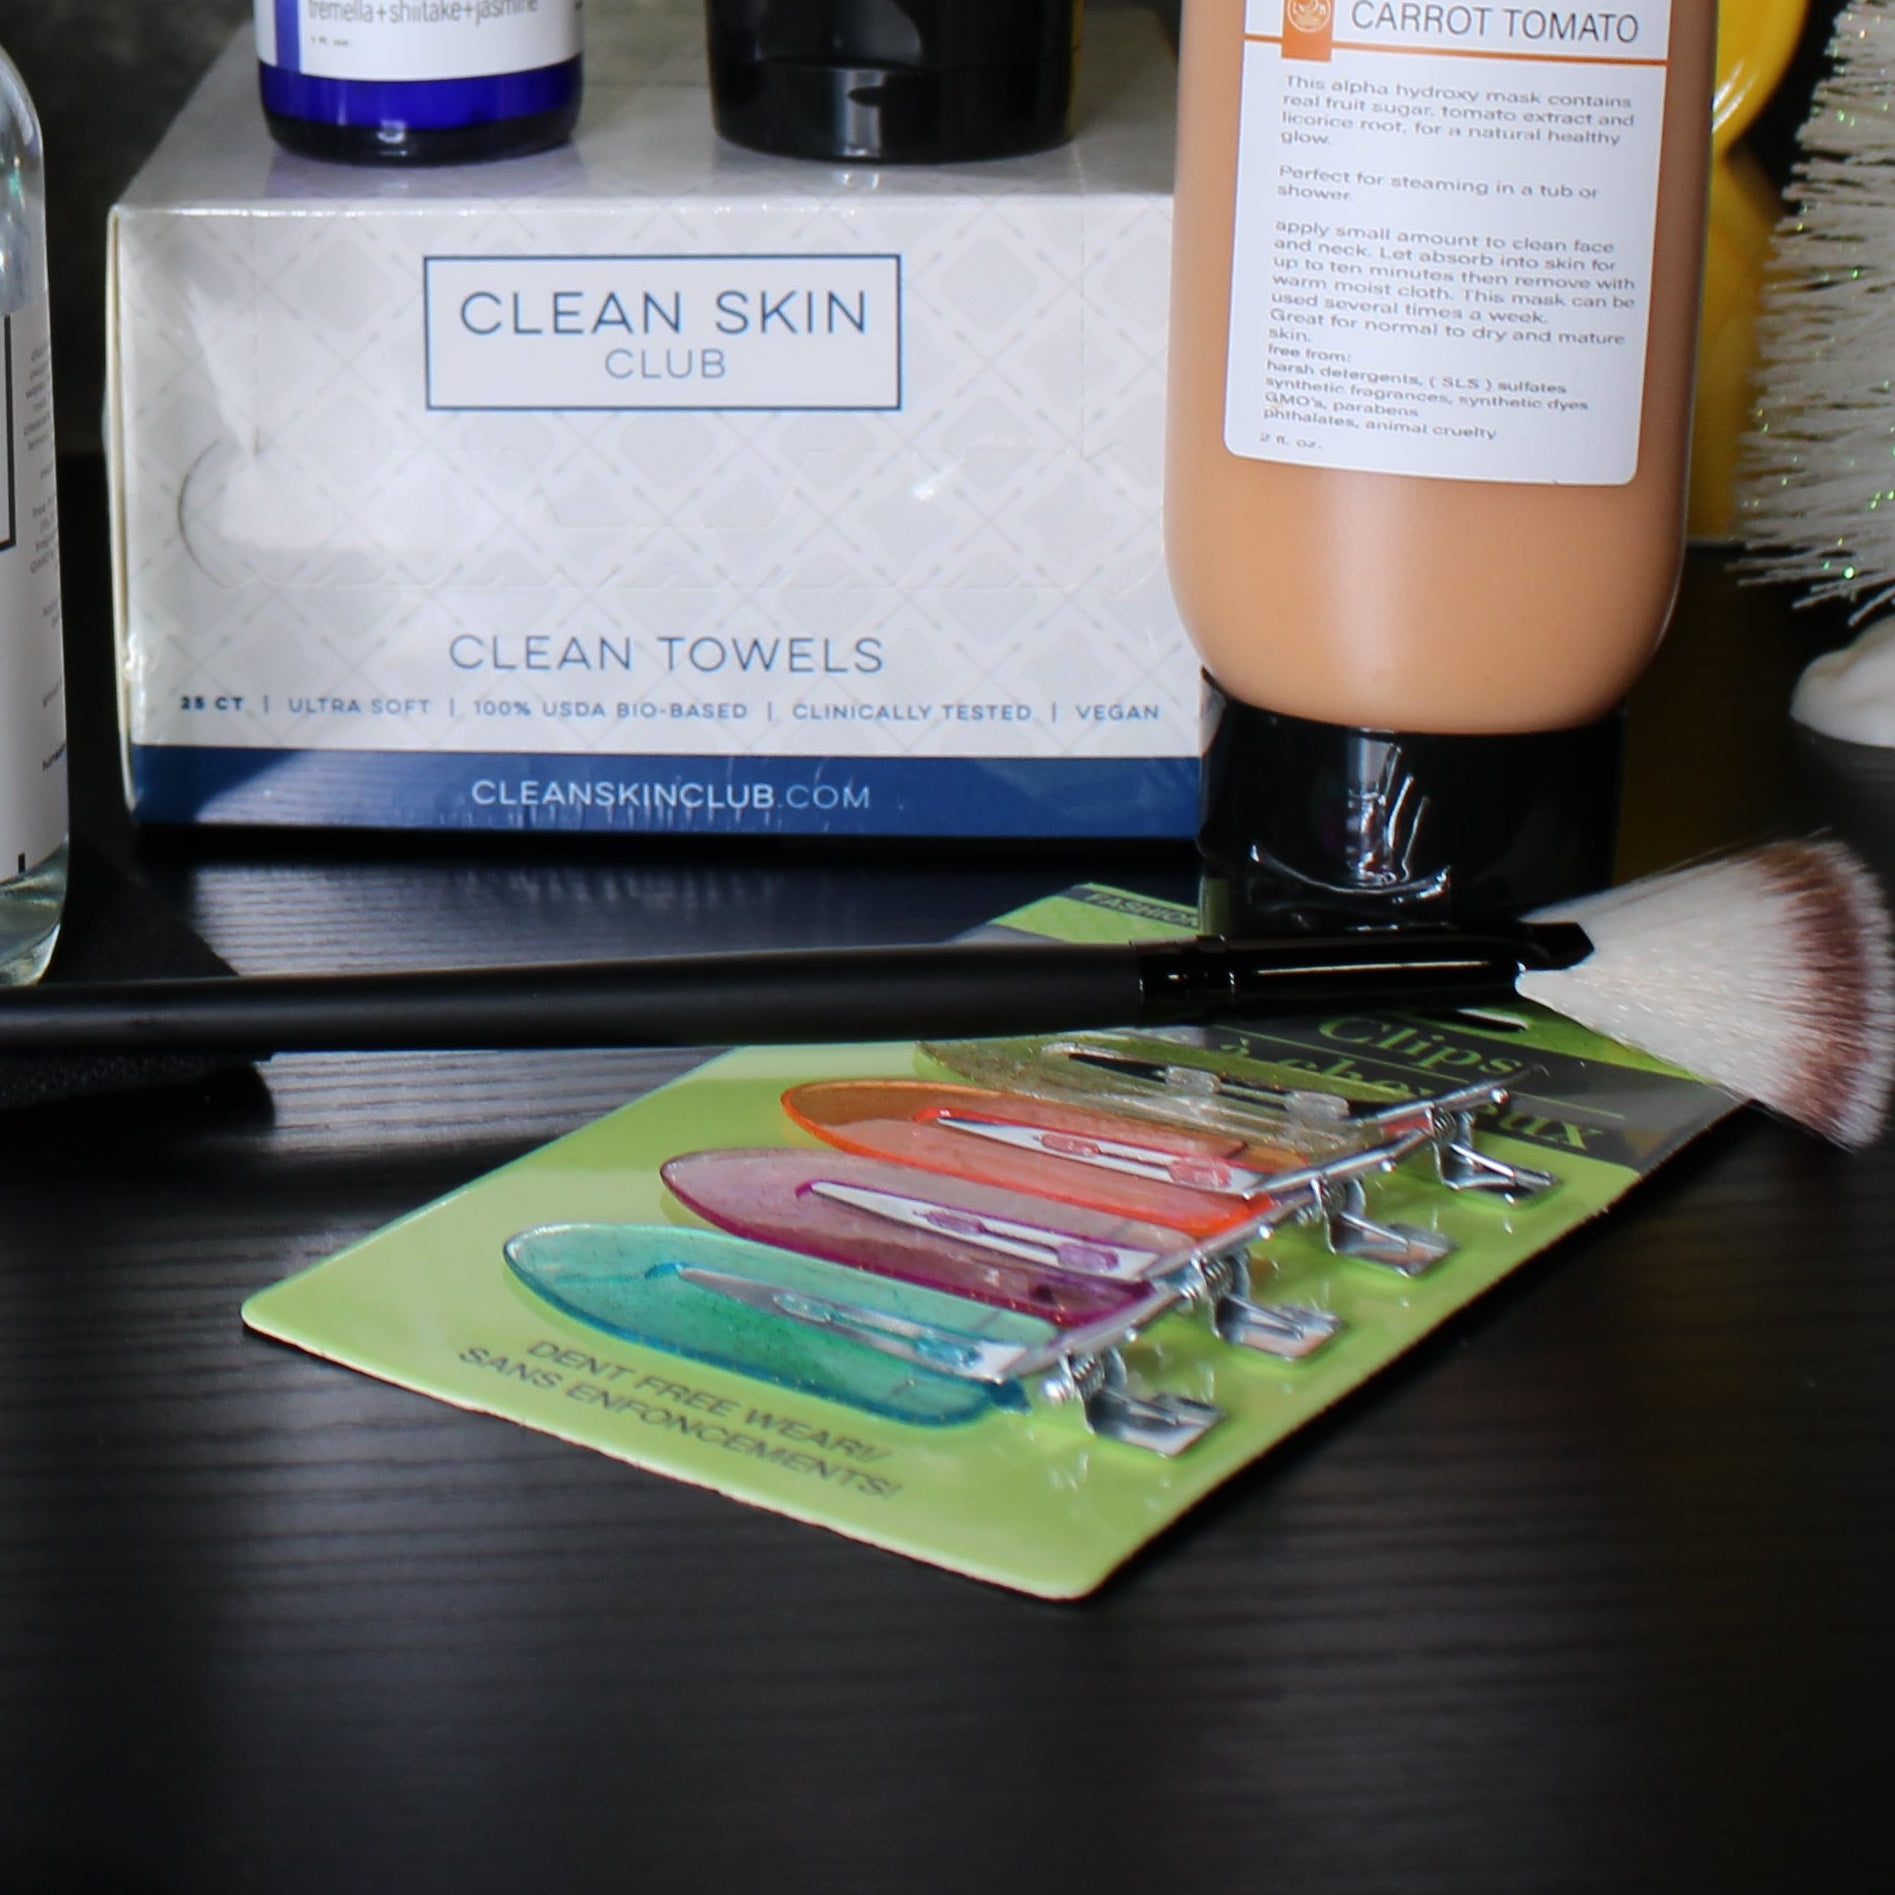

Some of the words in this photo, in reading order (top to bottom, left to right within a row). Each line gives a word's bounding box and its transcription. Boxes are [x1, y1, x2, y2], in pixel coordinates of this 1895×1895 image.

[1503, 7, 1639, 44] TOMATO
[1285, 74, 1325, 91] This
[1331, 78, 1389, 99] alpha
[1395, 83, 1480, 104] hydroxy
[1486, 89, 1542, 106] mask
[1547, 92, 1632, 109] contains
[1281, 110, 1354, 130] licorice
[1414, 120, 1442, 136] for
[1448, 125, 1461, 137] a
[1467, 124, 1542, 141] natural
[1547, 129, 1621, 147] healthy
[1282, 93, 1321, 108] real
[1325, 95, 1366, 112] fruit
[1441, 105, 1517, 123] tomato
[1522, 110, 1593, 127] extract
[1598, 113, 1635, 128] and
[460, 289, 684, 336] CLEAN
[714, 289, 867, 336] SKIN
[604, 347, 727, 380] CLUB
[449, 633, 633, 672] CLEAN
[656, 635, 885, 675] TOWELS
[215, 695, 244, 712] CT
[287, 697, 361, 715] ULTRA
[370, 697, 432, 716] SOFT
[475, 700, 531, 717] 100%
[541, 701, 606, 718] USDA
[616, 702, 748, 720] BIO-BASED
[792, 703, 932, 721] CLINICALLY
[941, 704, 1033, 722] TESTED
[1075, 704, 1161, 722] VEGAN
[470, 778, 871, 810] CLEANSKINCLUB.COM
[1319, 1016, 1524, 1075] Clips
[457, 1346, 564, 1390] SANS
[525, 1340, 637, 1382] DENT
[634, 1375, 742, 1417] FREE
